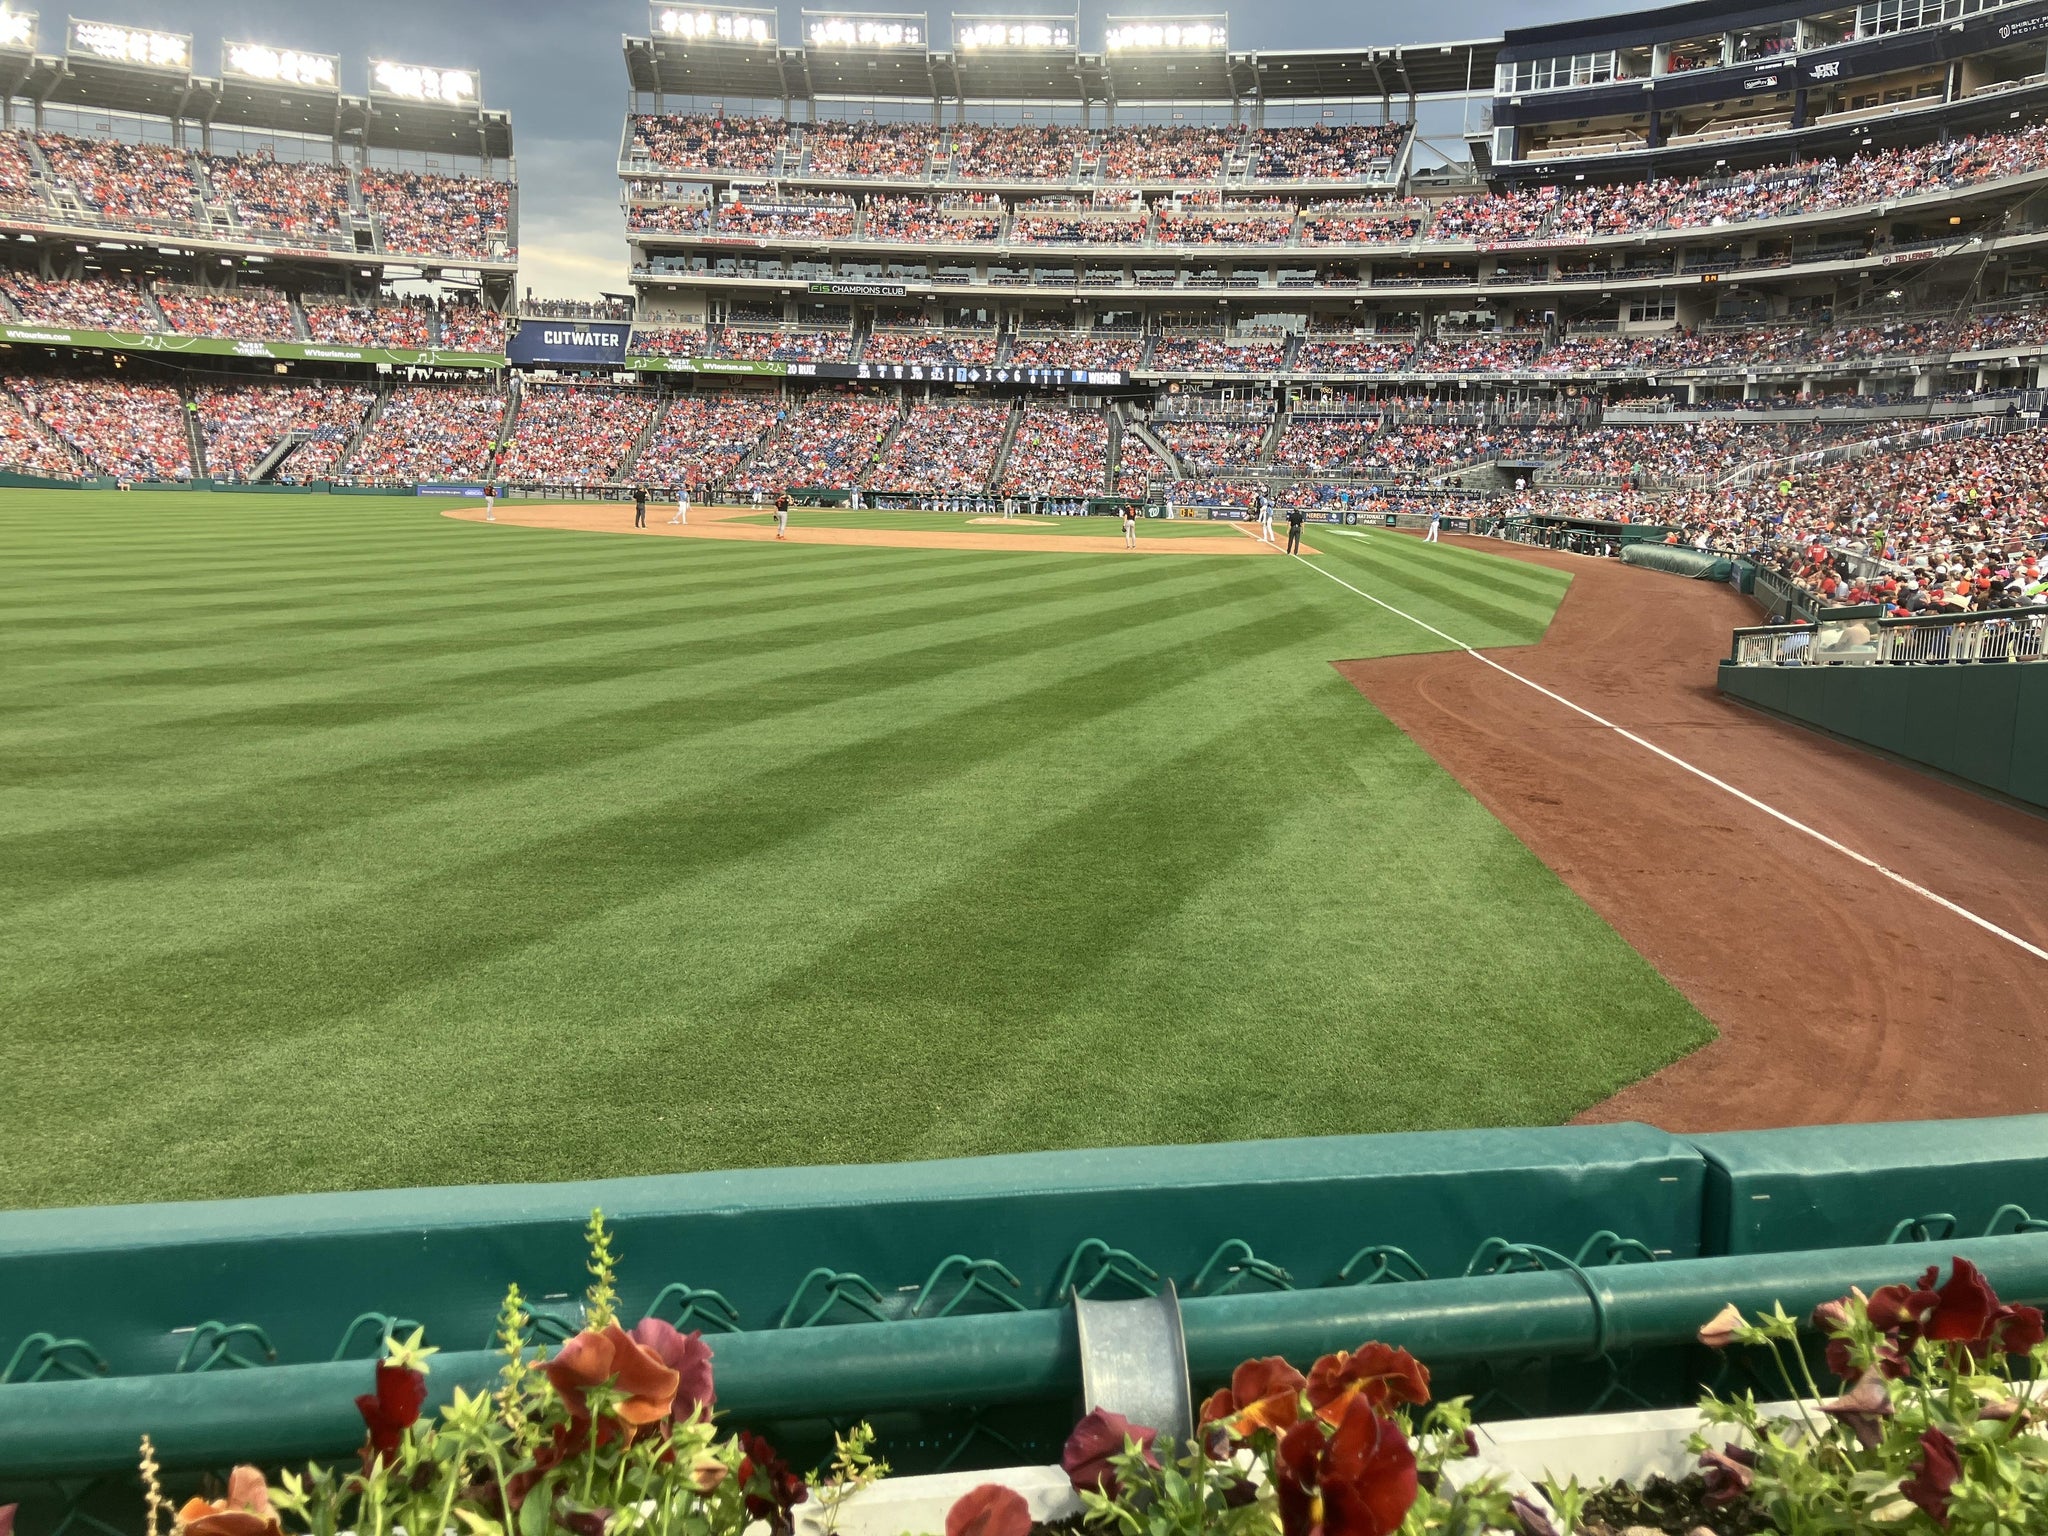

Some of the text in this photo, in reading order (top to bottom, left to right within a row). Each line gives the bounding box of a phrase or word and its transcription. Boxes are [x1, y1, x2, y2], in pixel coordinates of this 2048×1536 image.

[2011, 18, 2040, 30] SHIRLEY
[2012, 26, 2037, 35] MEDIA
[1508, 241, 1548, 249] WASHINGTON
[1550, 239, 1585, 247] NATIONALS
[1895, 250, 1933, 262] TED LERNER
[832, 285, 880, 294] CHAMPIONS
[882, 287, 904, 295] CLUB
[6, 330, 72, 342] WVtourism.com
[544, 330, 619, 347] CUTWATER
[304, 349, 362, 359] WVtourism.com
[703, 363, 754, 371] WVtourism.com
[1849, 361, 1873, 369] CARTER
[1883, 359, 1909, 367] DAWSON
[787, 364, 797, 374] 20
[798, 364, 816, 375] RUIZ
[1088, 371, 1121, 385] WIEMER
[1181, 384, 1201, 394] PNC
[1580, 385, 1602, 395] PNC
[1357, 513, 1385, 521] NATIONALS
